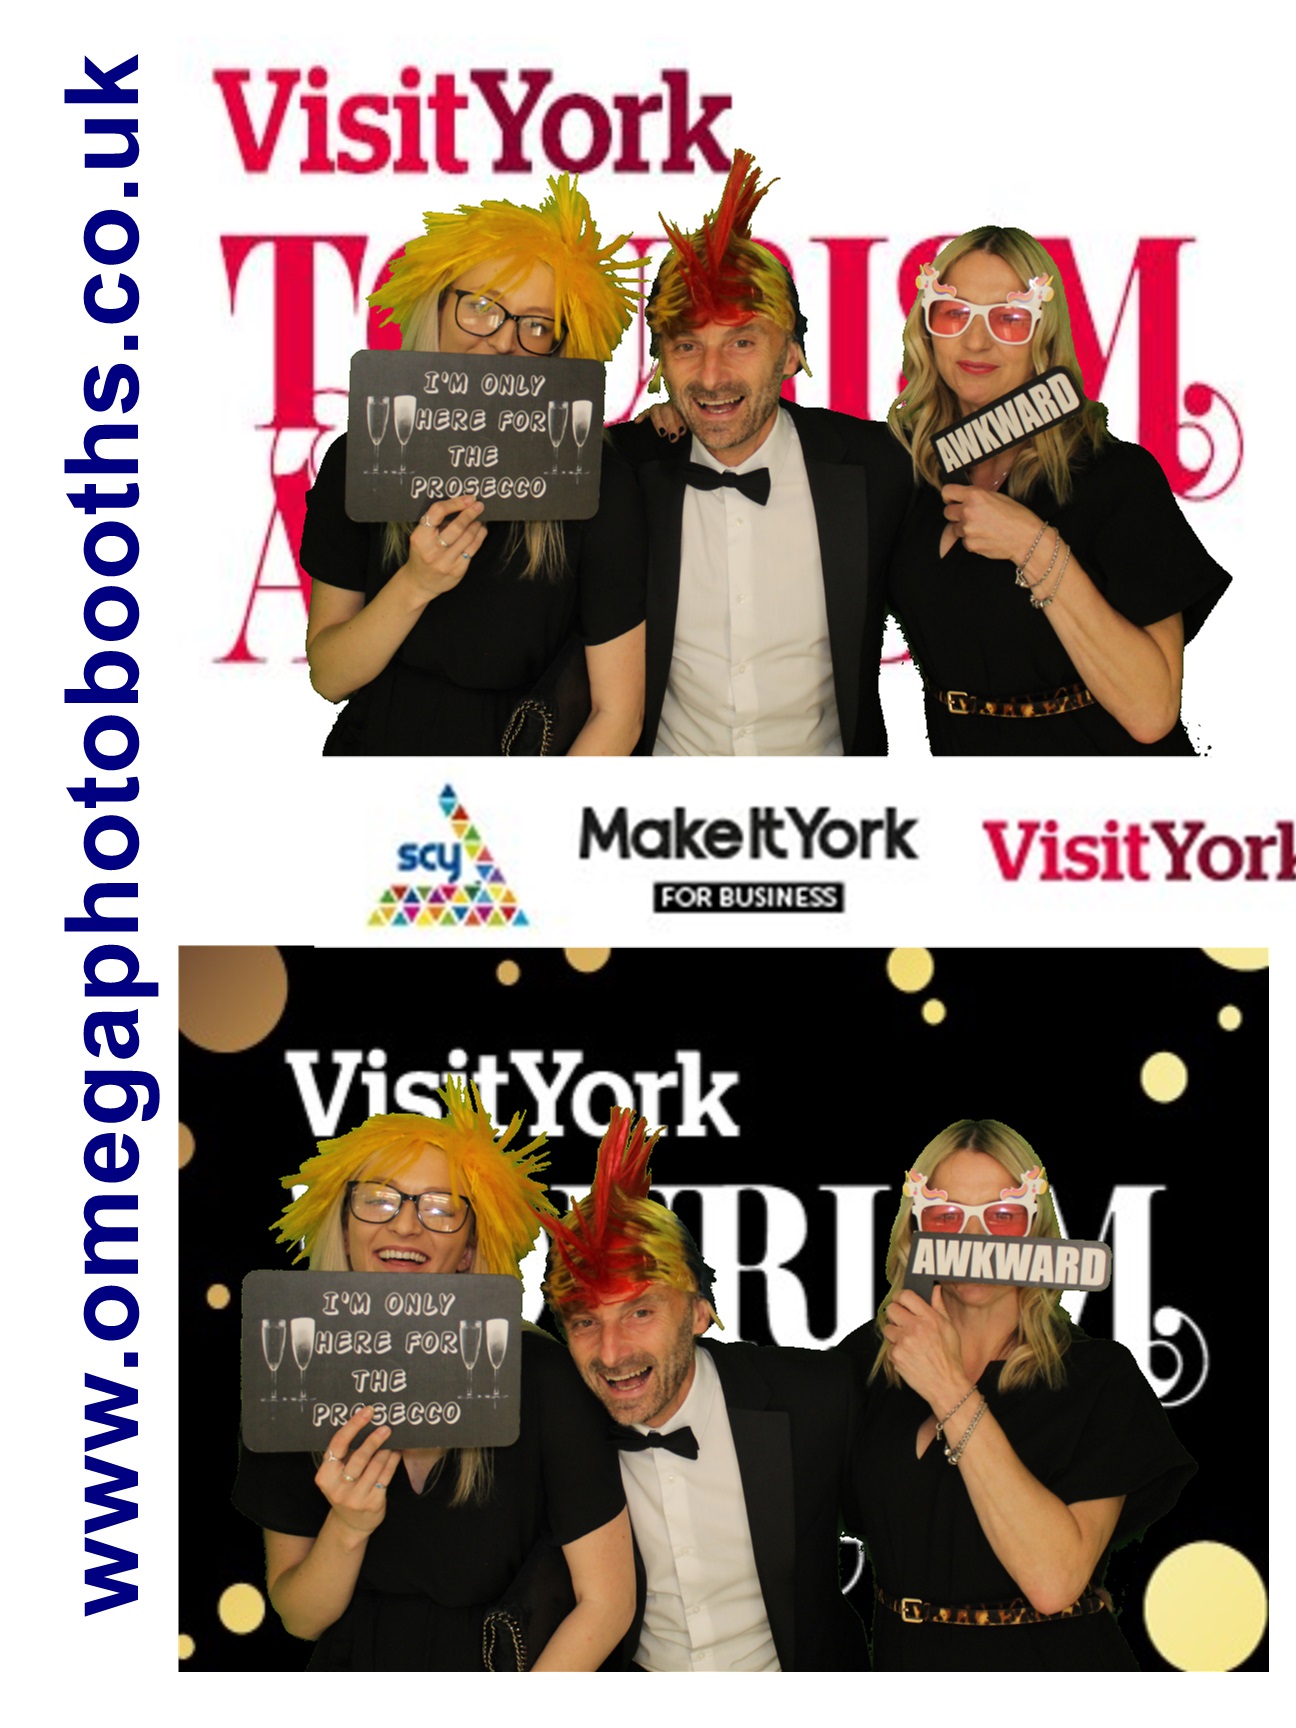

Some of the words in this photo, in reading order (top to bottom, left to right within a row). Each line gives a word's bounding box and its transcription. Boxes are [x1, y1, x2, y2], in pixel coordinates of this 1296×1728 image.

[424, 371, 468, 394] I'M
[480, 373, 546, 396] ONLY
[415, 408, 486, 431] HERE
[498, 410, 546, 432] FOR
[935, 372, 1081, 474] AWKWARD
[448, 446, 499, 468] THE
[410, 476, 547, 498] PROSECCO
[912, 1238, 1107, 1286] AWKWARD
[322, 1291, 371, 1316] I'M
[384, 1292, 455, 1316] ONLY
[314, 1331, 392, 1354] HERE
[405, 1331, 458, 1354] FOR
[352, 1369, 407, 1392] THE
